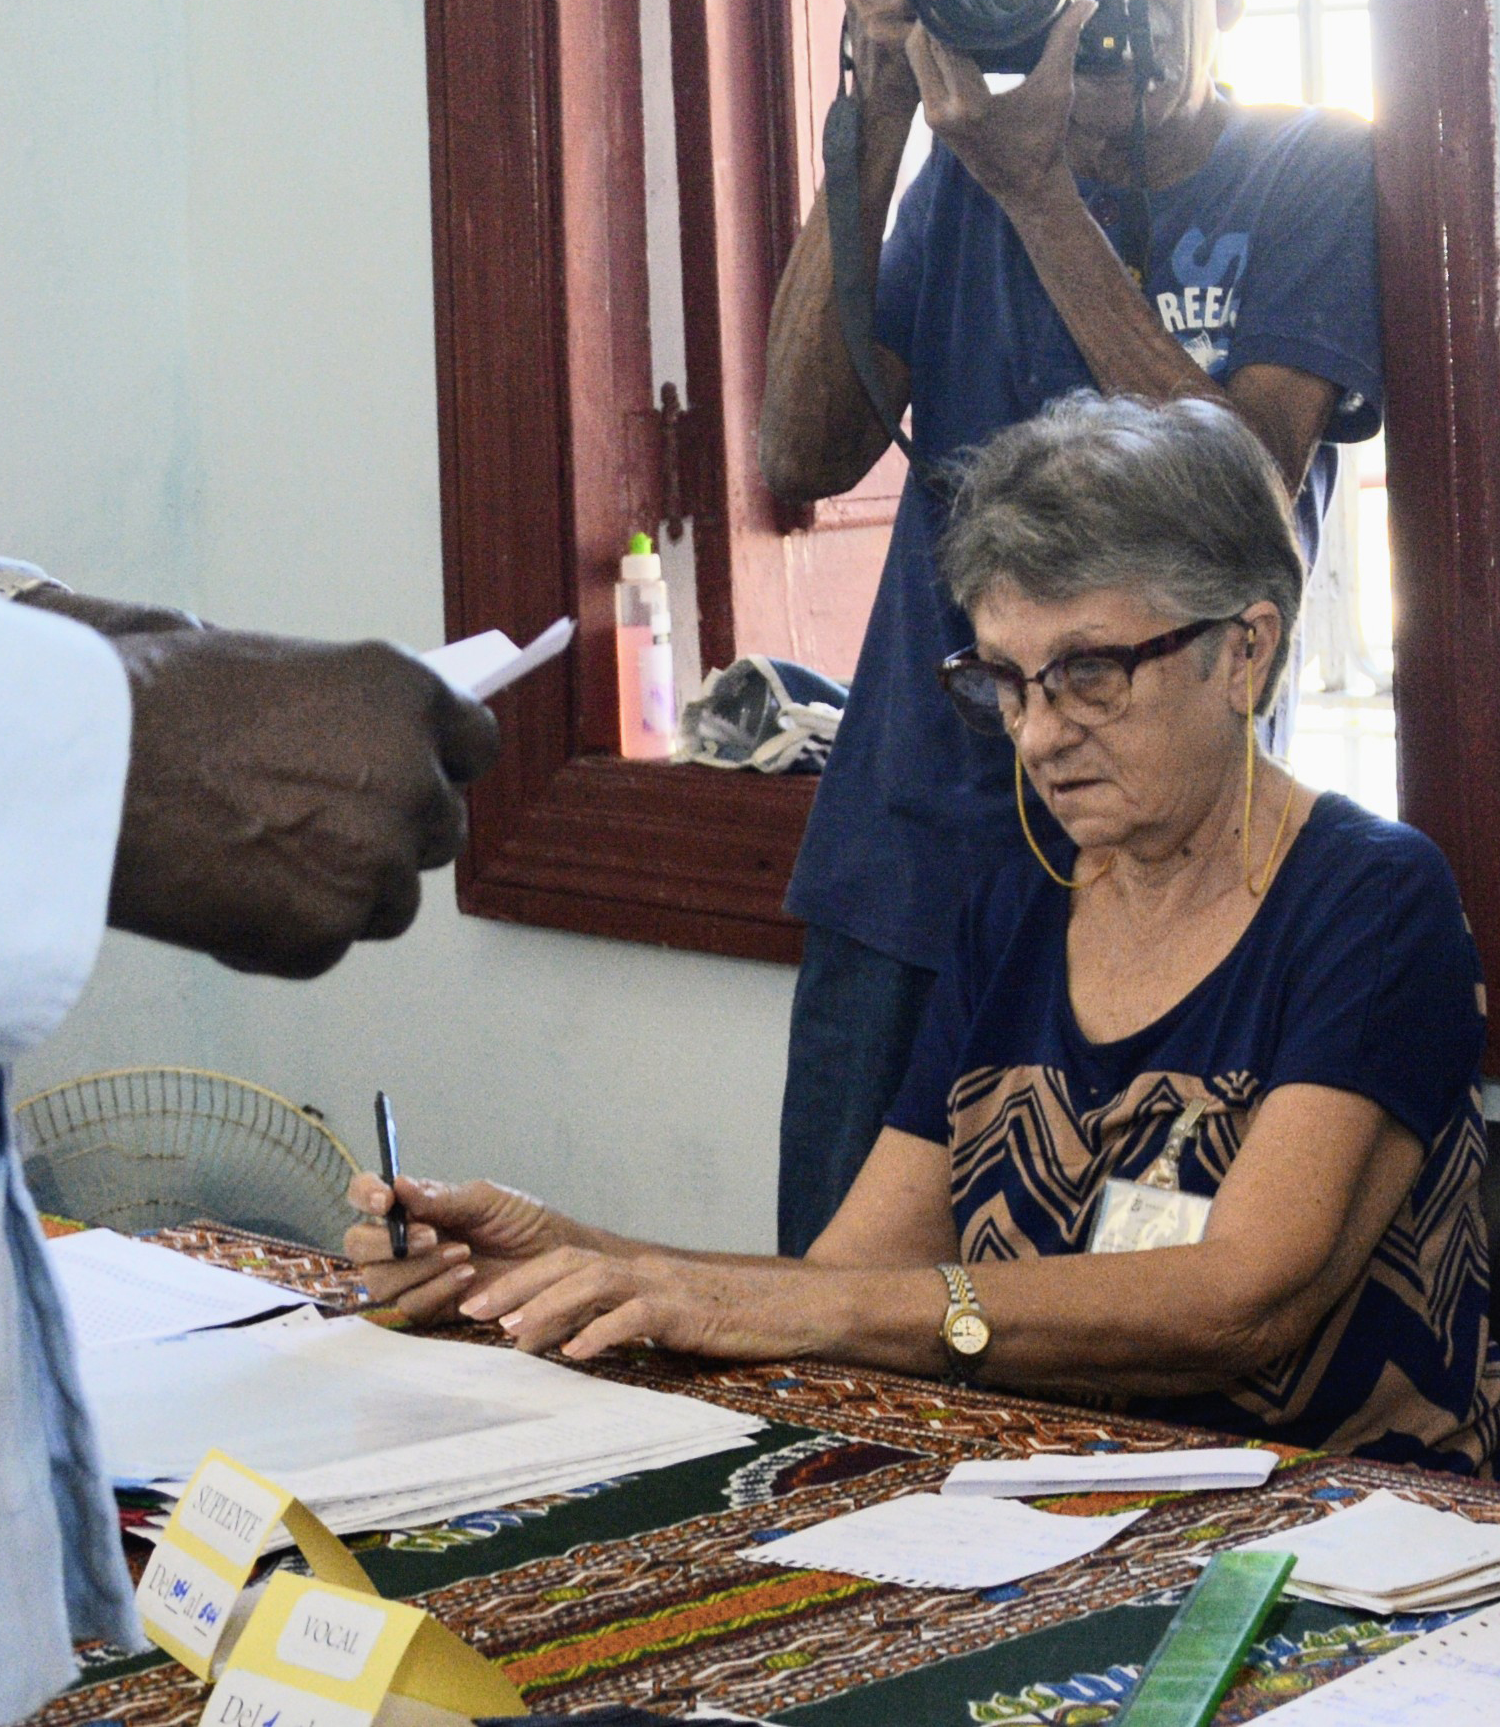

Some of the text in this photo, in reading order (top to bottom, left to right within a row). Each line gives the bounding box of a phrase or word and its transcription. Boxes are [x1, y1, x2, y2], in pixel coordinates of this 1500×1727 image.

[192, 1484, 263, 1543] SUPLENTE
[149, 1563, 177, 1600] Del
[183, 1592, 203, 1619] al
[303, 1615, 361, 1654] VOCAL
